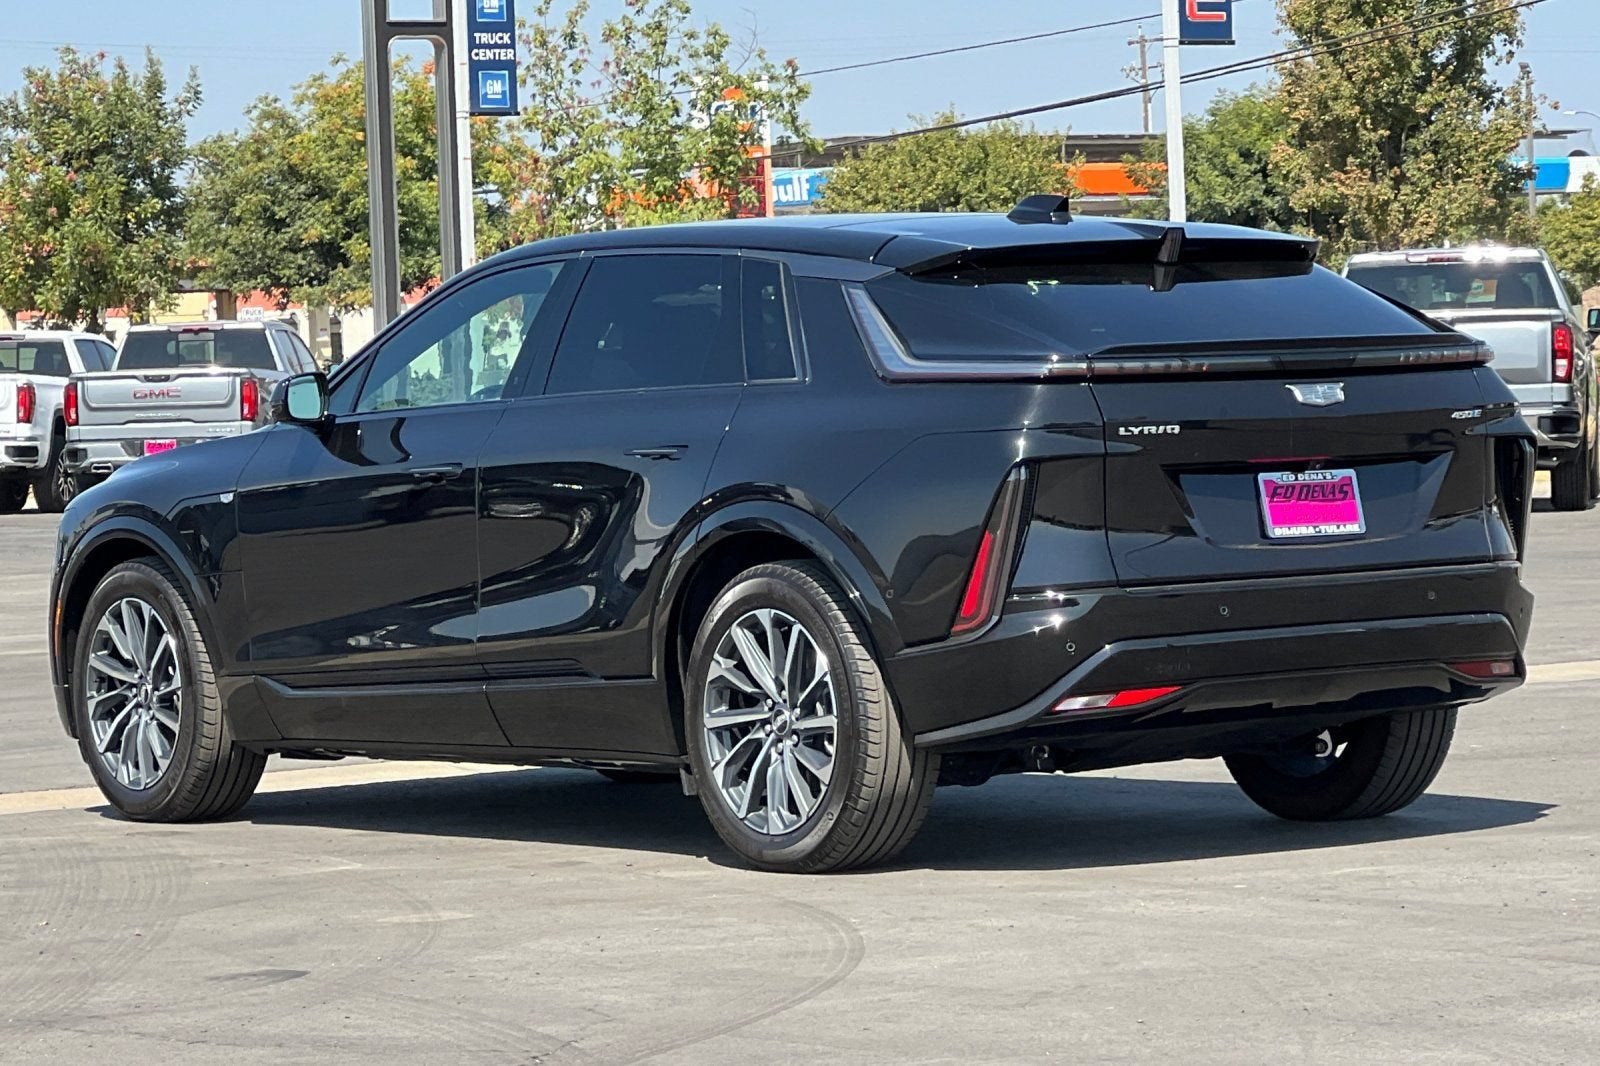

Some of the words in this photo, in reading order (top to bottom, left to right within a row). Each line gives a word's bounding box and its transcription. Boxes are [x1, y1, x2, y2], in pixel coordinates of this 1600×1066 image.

[474, 32, 511, 44] TRUCK
[471, 49, 515, 60] CENTER
[486, 79, 502, 95] GM
[773, 174, 810, 202] ulf
[133, 387, 181, 400] GMC
[1118, 425, 1180, 436] LYRIQ
[1297, 472, 1332, 481] DENA'S
[1269, 484, 1296, 504] ED
